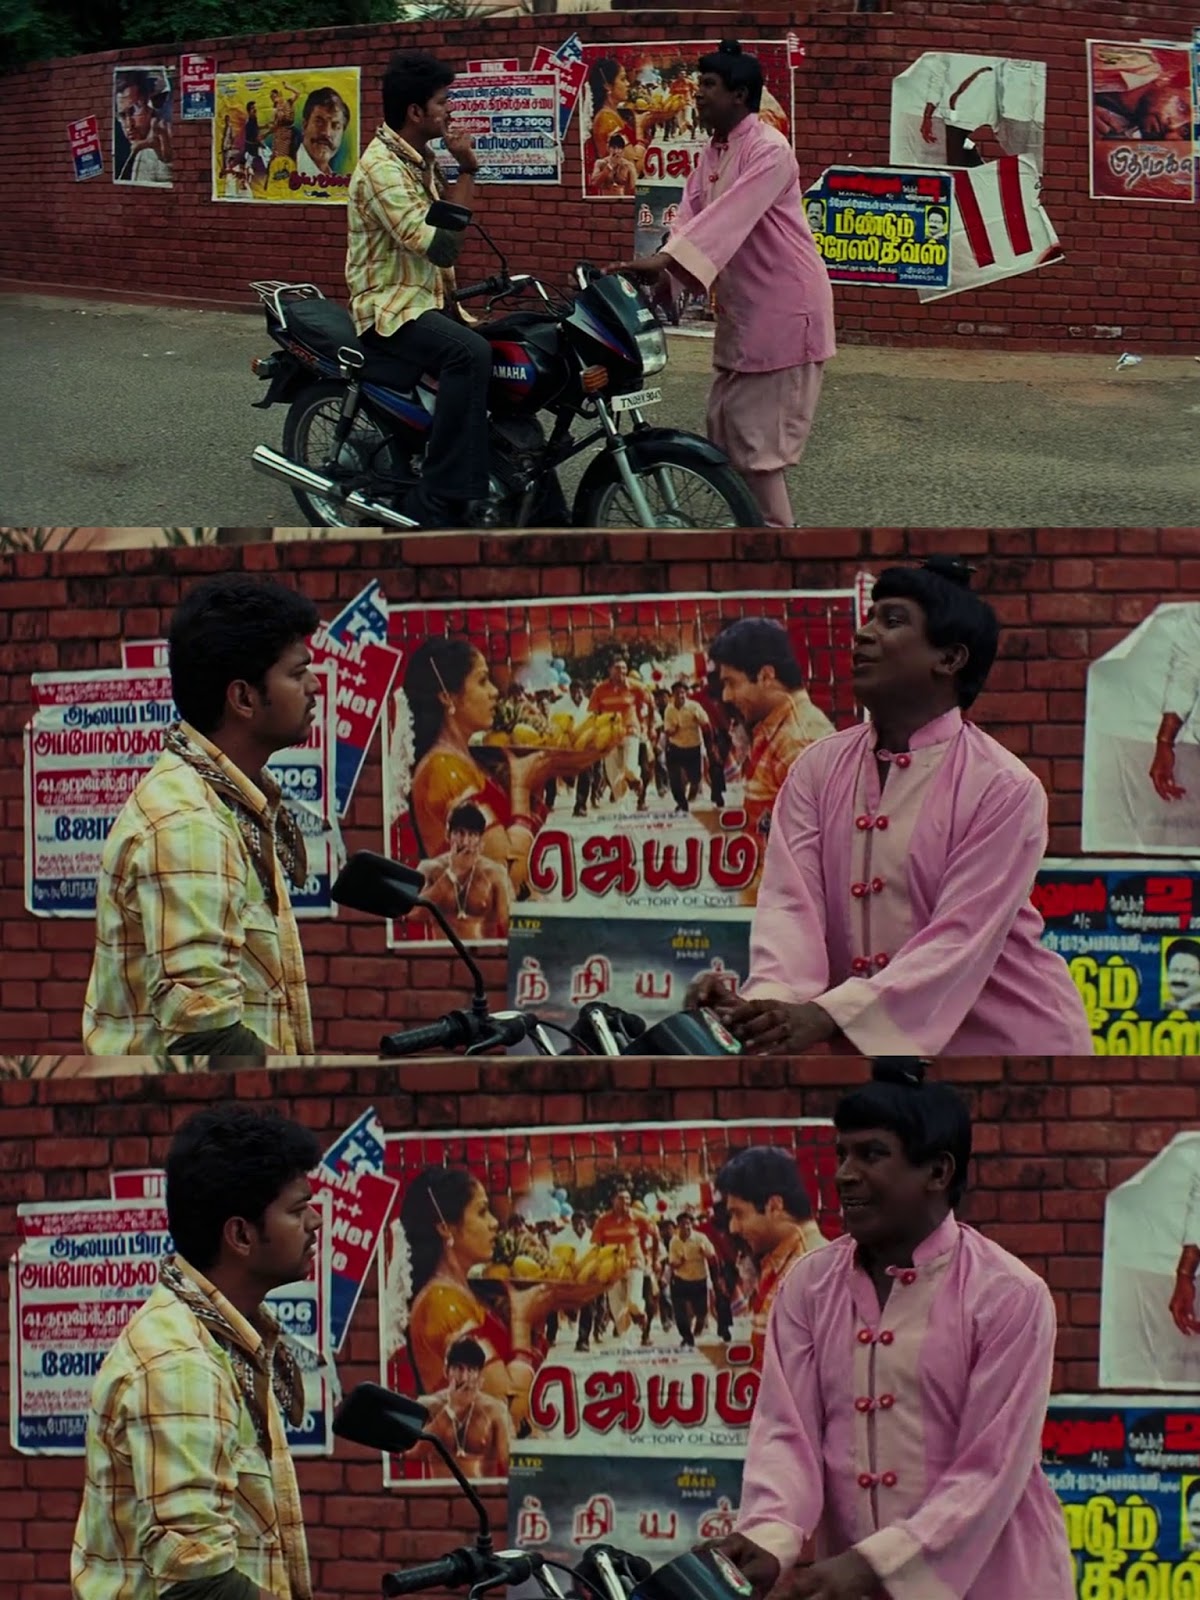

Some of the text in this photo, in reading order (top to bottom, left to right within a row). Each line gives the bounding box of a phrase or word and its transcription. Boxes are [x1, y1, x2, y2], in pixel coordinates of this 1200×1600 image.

[834, 207, 915, 239] மீண்டும்
[492, 366, 528, 380] AMAHA
[528, 808, 759, 901] ஜெயம்
[625, 896, 678, 907] VICTORY
[682, 895, 699, 906] OF
[530, 1344, 764, 1439] ஜெயம்
[629, 1434, 685, 1445] VICTORY
[688, 1434, 704, 1445] OF
